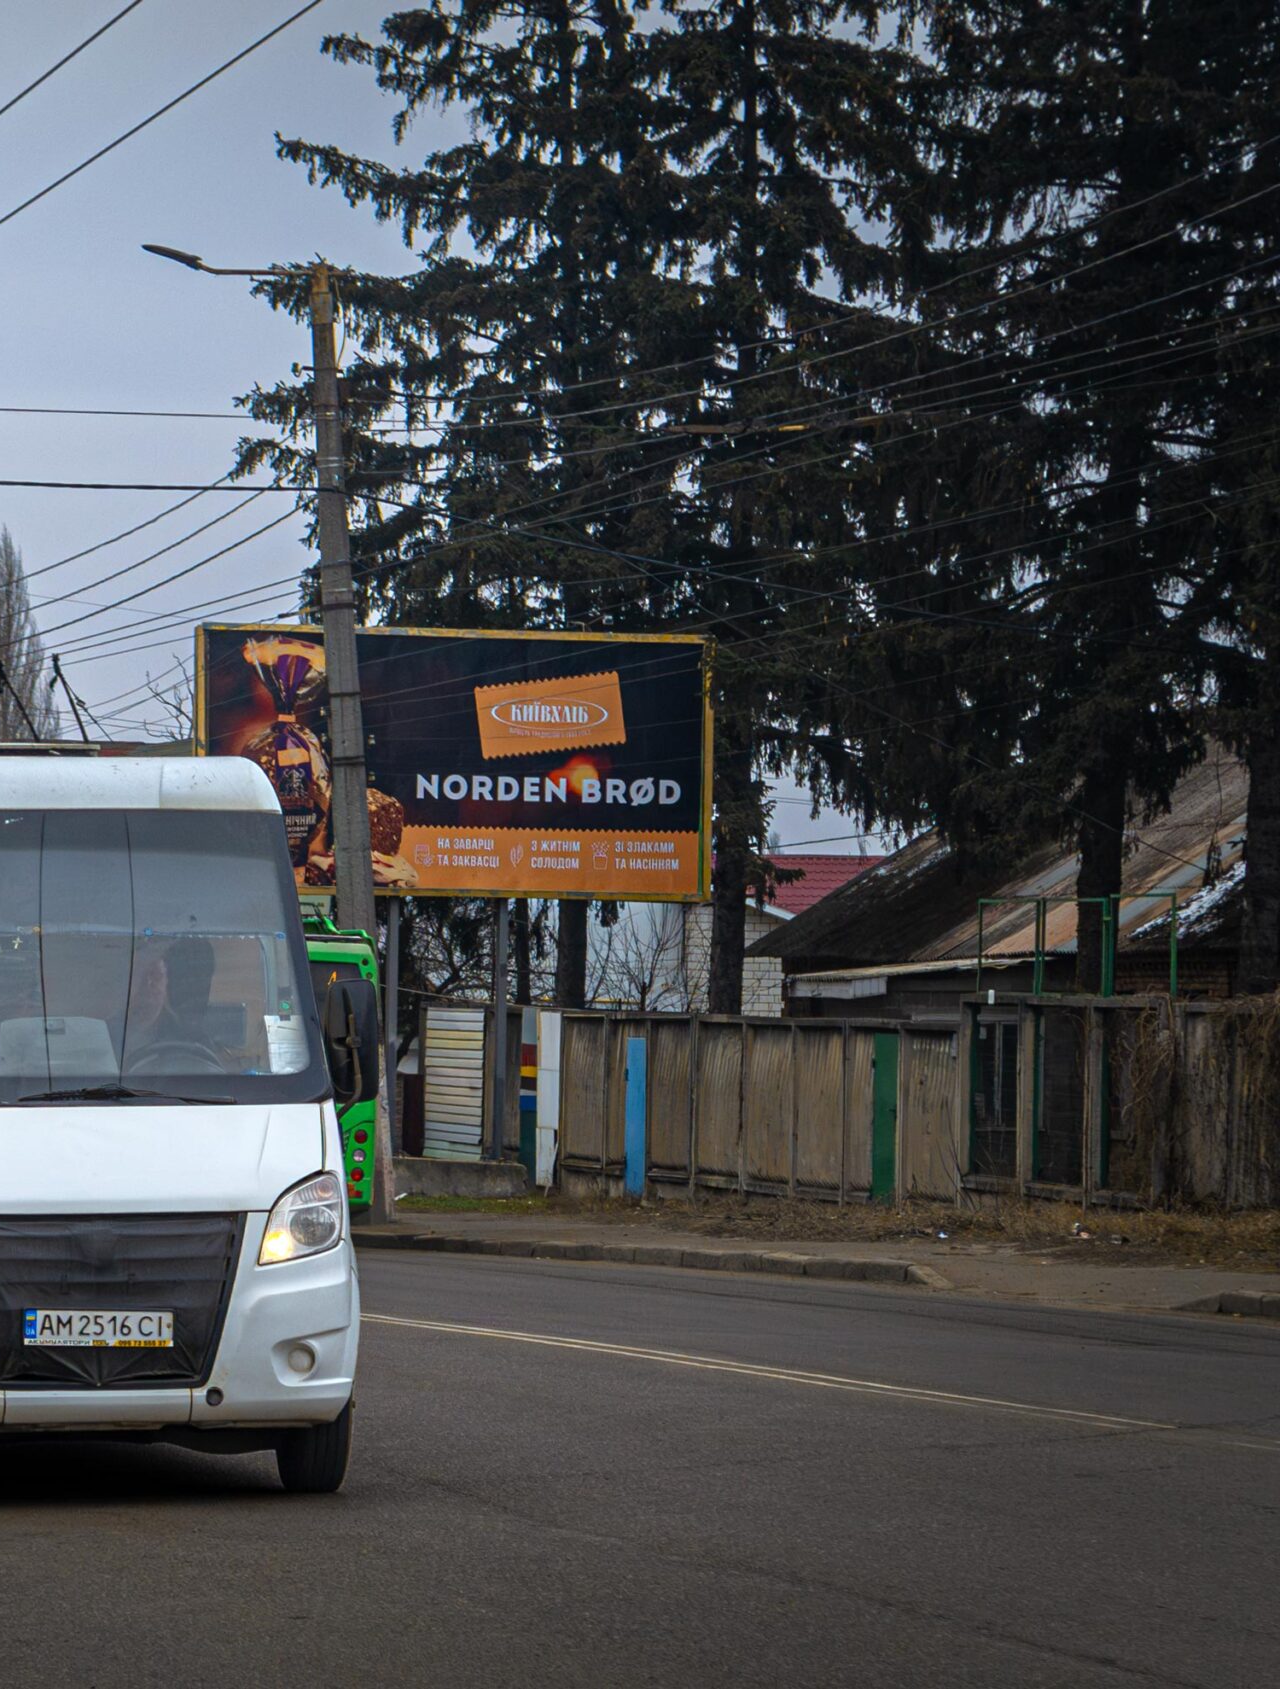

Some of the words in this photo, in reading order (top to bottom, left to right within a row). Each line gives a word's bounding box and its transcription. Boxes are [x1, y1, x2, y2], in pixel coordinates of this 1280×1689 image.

[511, 701, 589, 723] КИЇВХЛІБ
[416, 774, 567, 803] NORDEN
[581, 776, 681, 806] BRØD
[437, 838, 450, 849] НА
[453, 838, 494, 851] ЗАВАРЦІ
[531, 840, 538, 851] З
[541, 840, 581, 852] ЖИТНІМ
[615, 842, 624, 853] ЗІ
[627, 842, 675, 853] ЗЛАКАМИ
[437, 855, 449, 867] ТА
[452, 855, 499, 868] ЗАКВАСЦІ
[531, 857, 579, 869] СОЛОДОМ
[615, 858, 626, 869] ТА
[629, 858, 679, 870] НАСІННЯМ
[25, 1329, 36, 1337] UA
